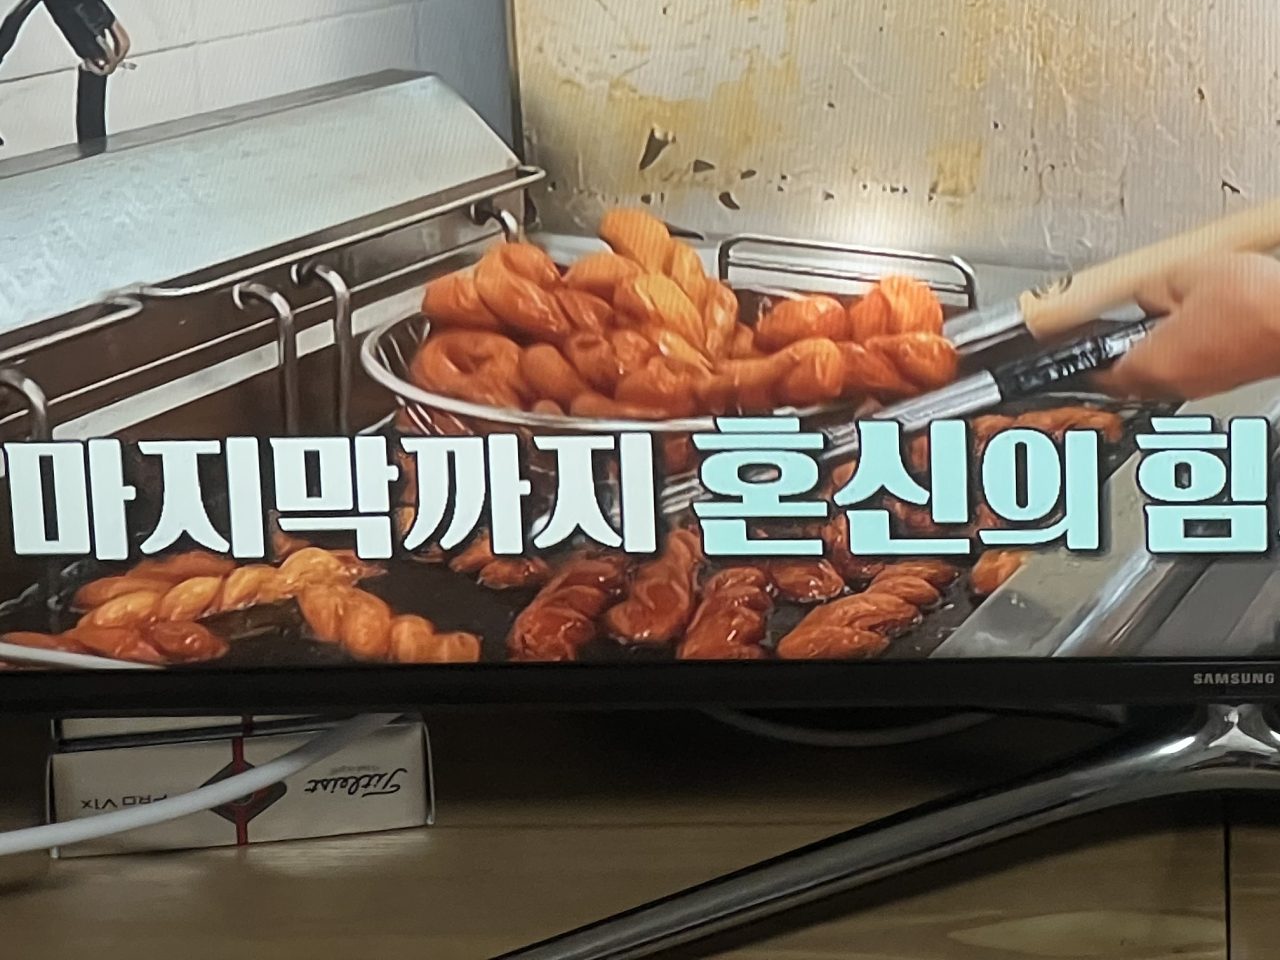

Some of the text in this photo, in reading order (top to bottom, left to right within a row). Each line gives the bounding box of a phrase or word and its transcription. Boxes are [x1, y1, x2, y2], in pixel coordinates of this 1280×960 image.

[692, 416, 1100, 556] 혼신의
[1193, 672, 1275, 685] SAMSUNG
[304, 767, 408, 798] Titleist
